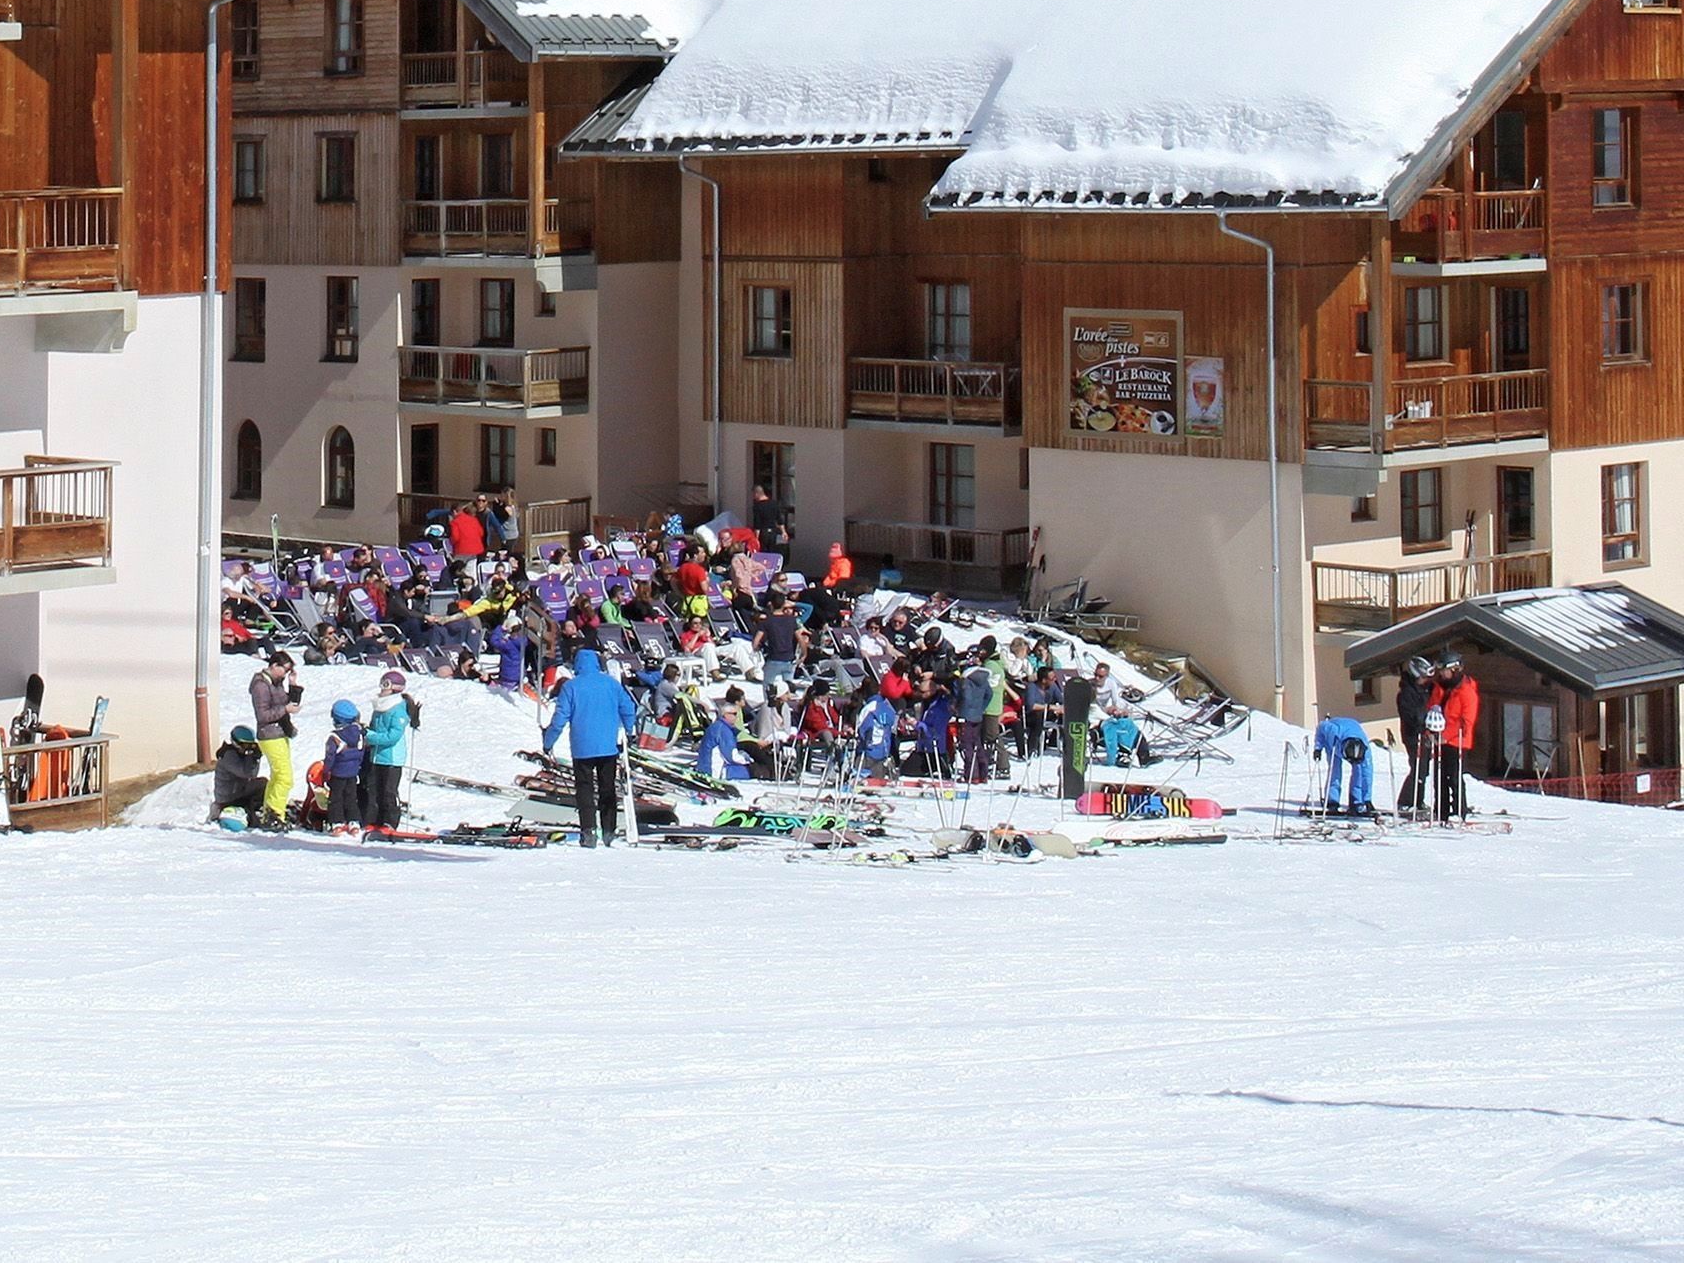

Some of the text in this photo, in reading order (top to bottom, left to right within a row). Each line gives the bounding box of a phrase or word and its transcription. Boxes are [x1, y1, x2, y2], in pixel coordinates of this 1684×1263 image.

[1105, 341, 1139, 356] pistes
[1118, 383, 1168, 392] RESTAURANT
[1137, 392, 1171, 400] PIZZERIA
